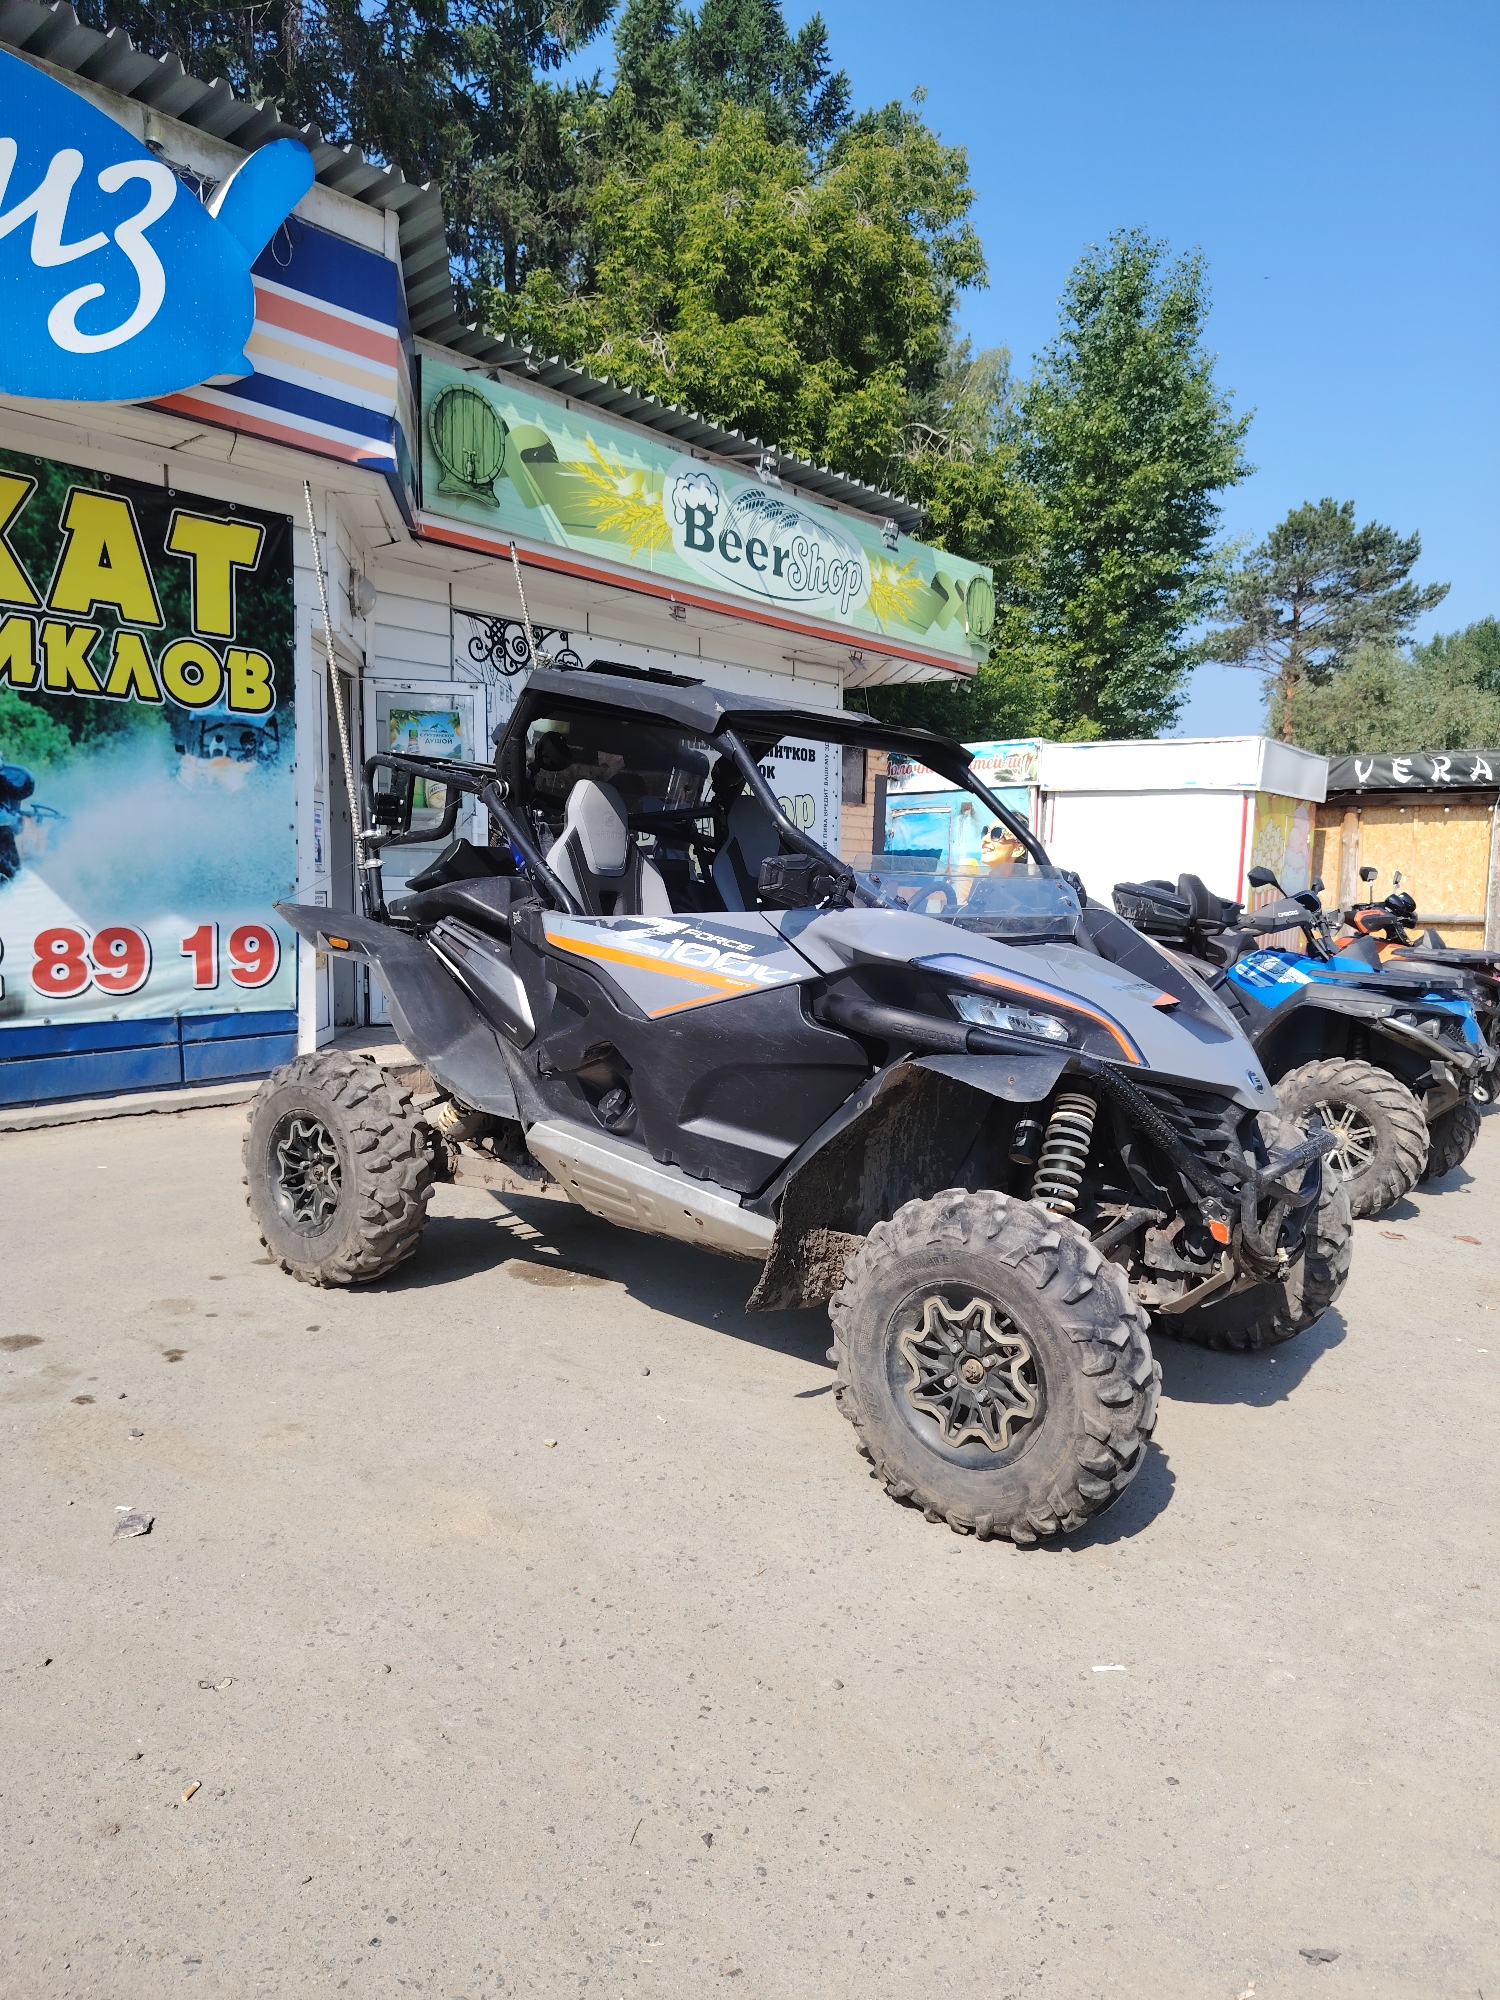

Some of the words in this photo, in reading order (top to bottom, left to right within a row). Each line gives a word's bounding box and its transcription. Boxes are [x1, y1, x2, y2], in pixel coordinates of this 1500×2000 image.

[424, 737, 453, 745] ДУШОЙ
[1354, 755, 1493, 783] VERA
[681, 928, 756, 953] FORCE
[31, 923, 153, 999] 89
[180, 921, 281, 990] 19
